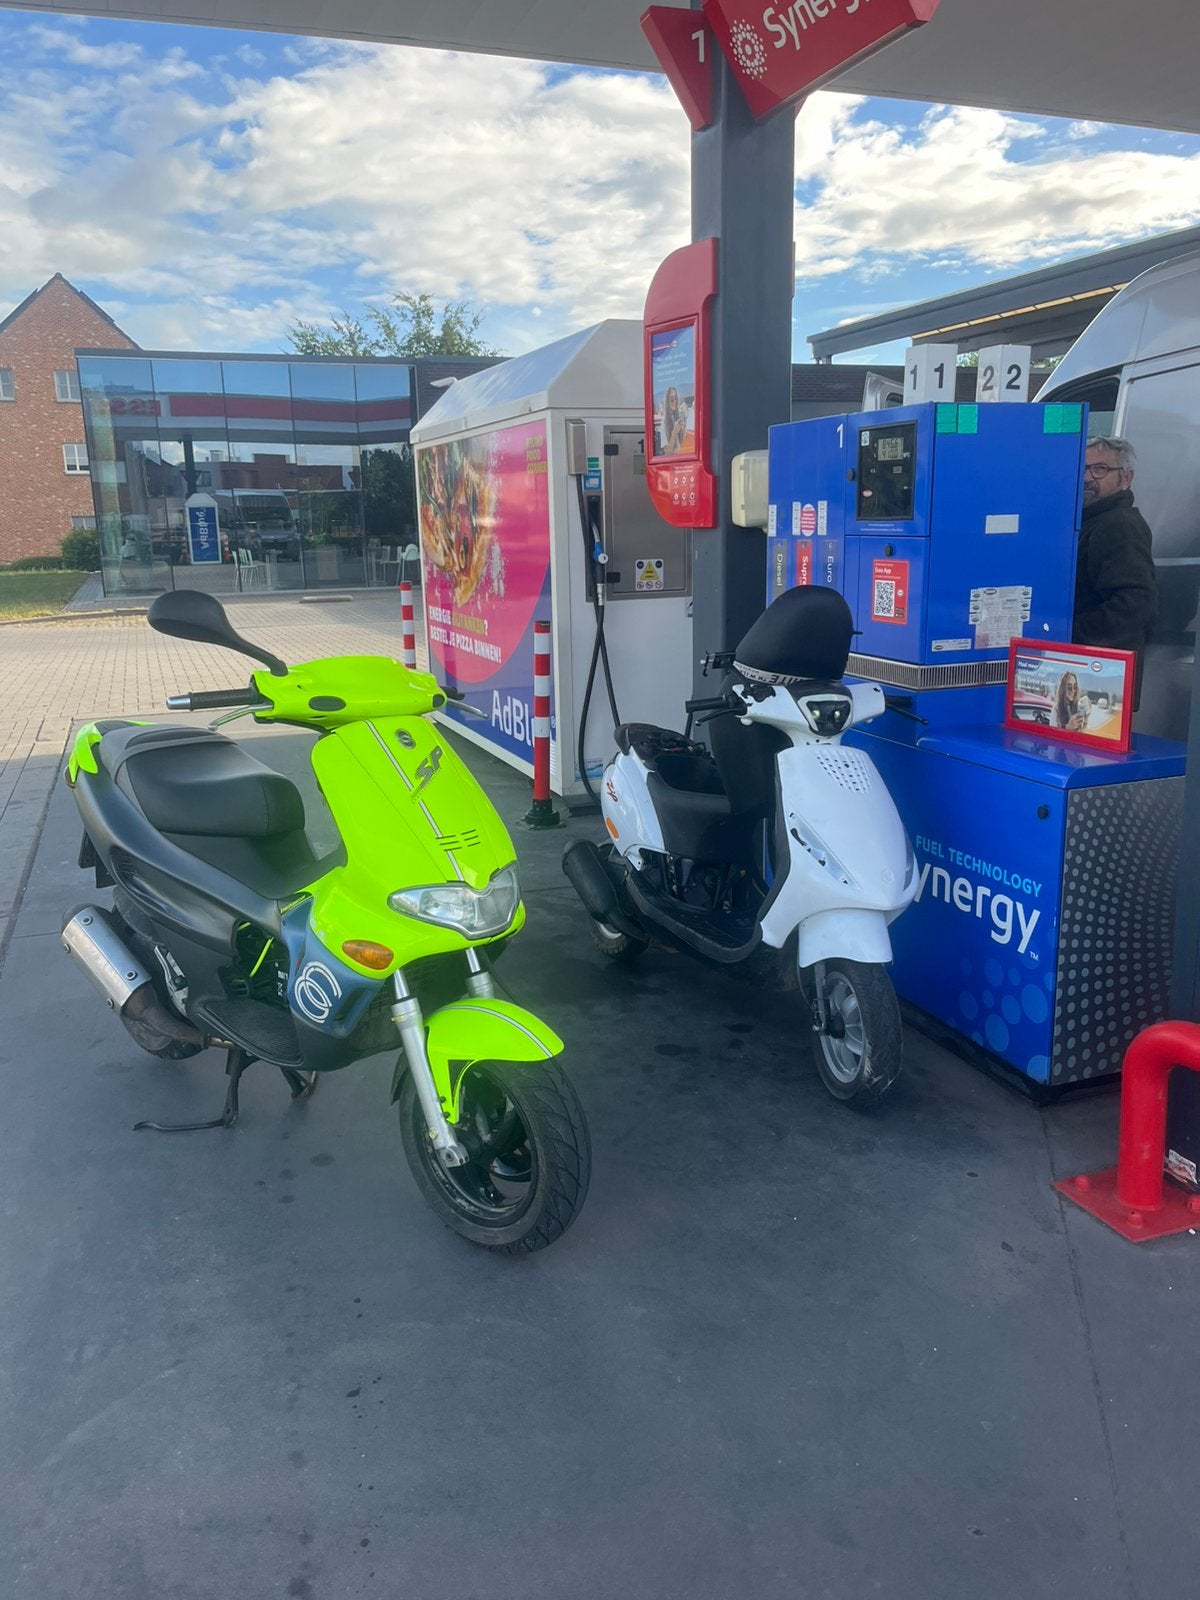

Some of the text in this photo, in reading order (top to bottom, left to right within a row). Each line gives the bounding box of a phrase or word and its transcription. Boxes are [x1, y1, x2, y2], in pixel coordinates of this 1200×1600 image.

[691, 29, 705, 63] 1
[910, 364, 918, 390] 1
[934, 362, 944, 389] 1
[981, 365, 995, 392] 2
[1005, 364, 1022, 390] 2
[638, 438, 645, 454] 1
[836, 423, 844, 449] 1
[776, 553, 784, 587] Diesel
[826, 555, 835, 583] Euro
[455, 632, 475, 655] PIZZA
[915, 834, 1043, 898] FUEL TECHNOLOGY
[914, 862, 1041, 955] ynergy
